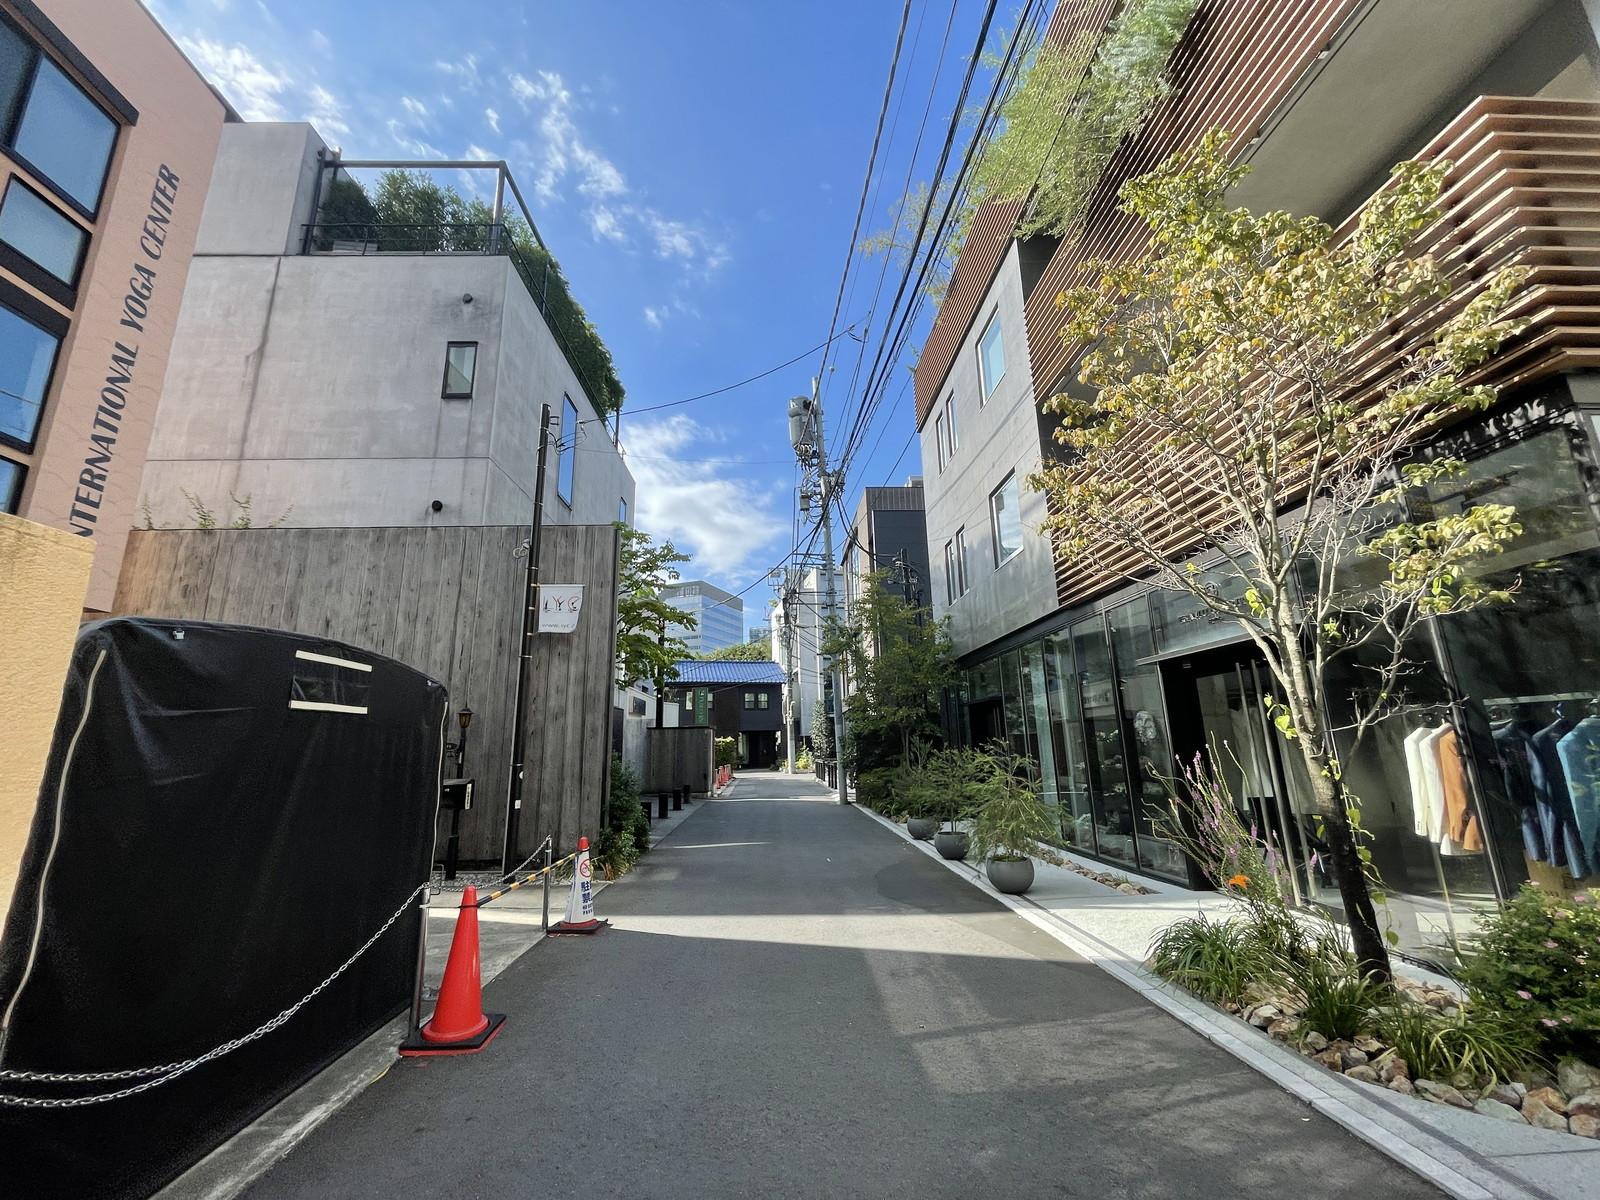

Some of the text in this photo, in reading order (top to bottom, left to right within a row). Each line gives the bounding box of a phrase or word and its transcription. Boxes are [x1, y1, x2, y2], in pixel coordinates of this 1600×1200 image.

[69, 163, 180, 537] NTERNATIONAL YOGA CENTER
